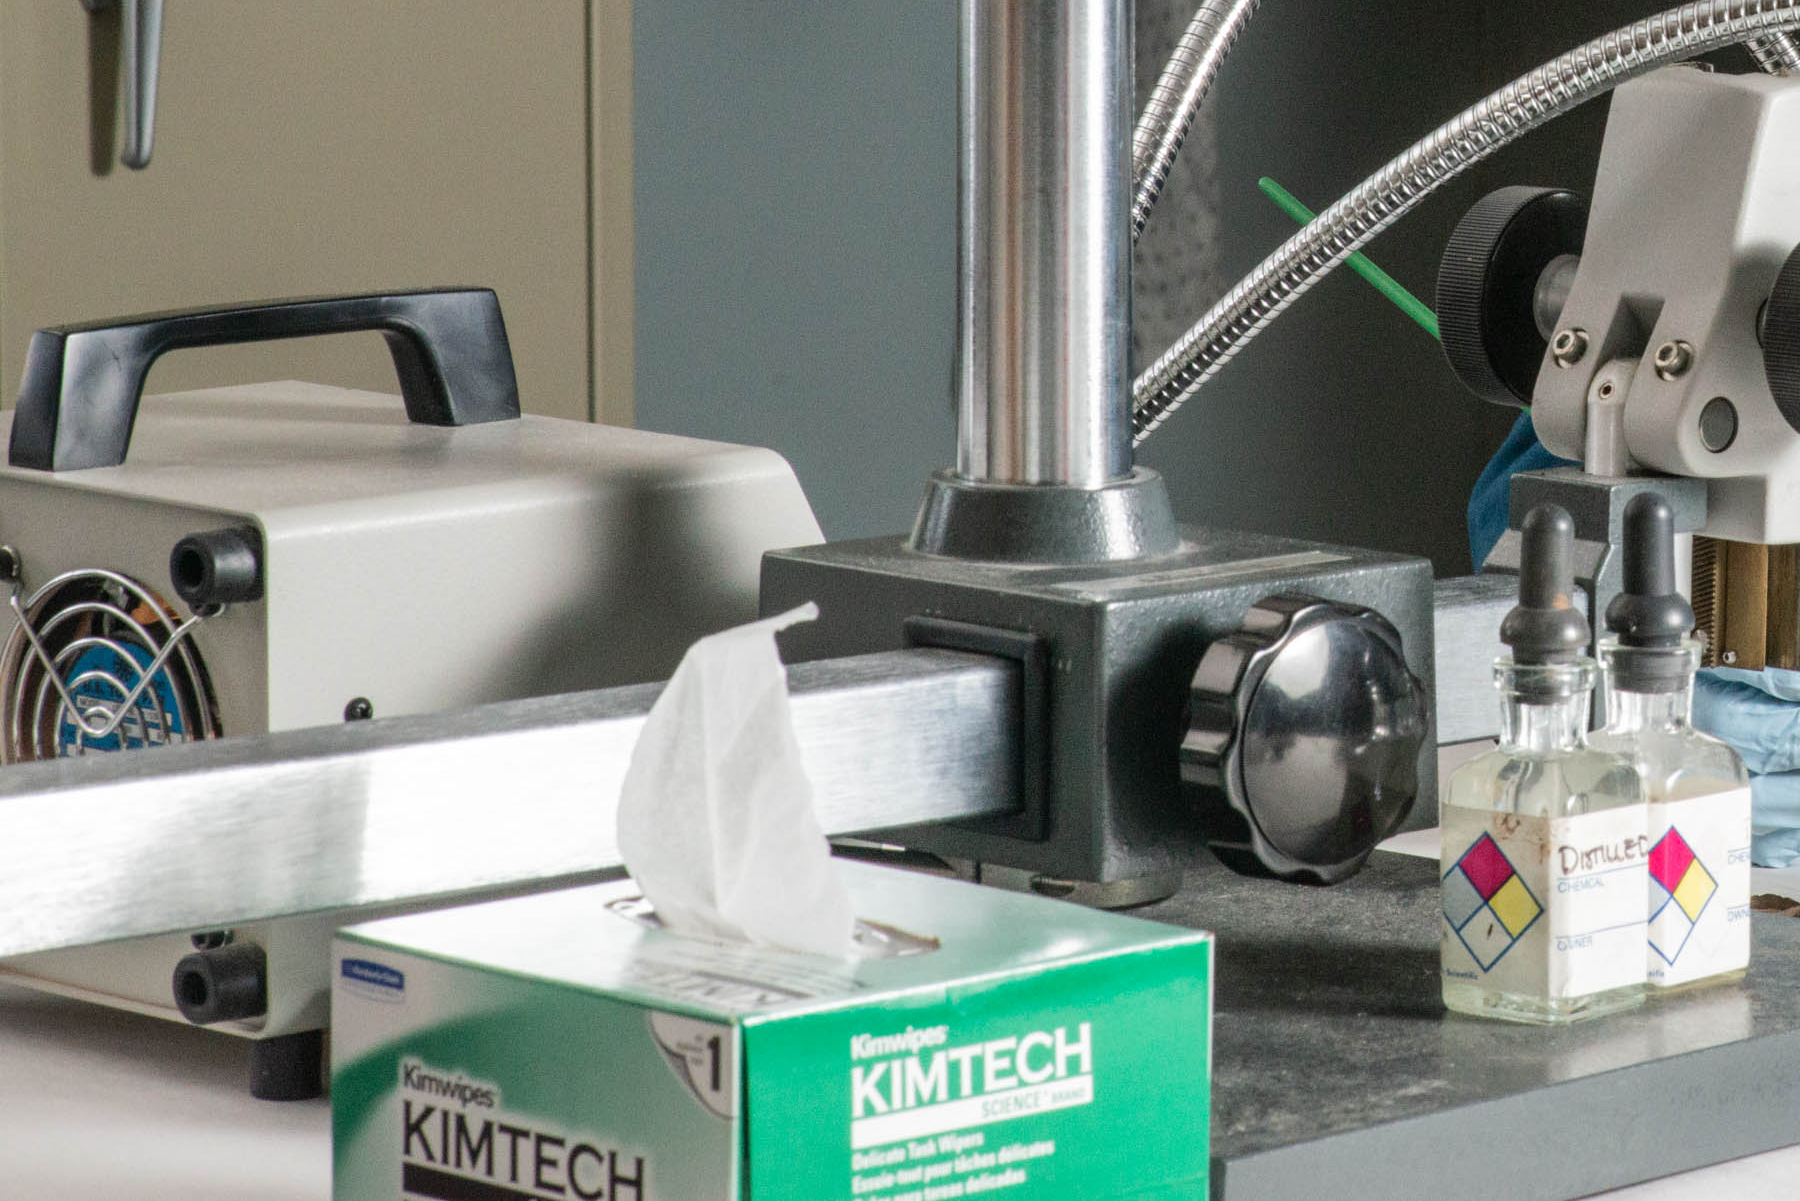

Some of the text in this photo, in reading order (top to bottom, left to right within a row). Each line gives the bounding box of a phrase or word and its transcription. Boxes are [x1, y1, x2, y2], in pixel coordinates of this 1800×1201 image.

[707, 1035, 720, 1091] 1
[851, 1025, 949, 1060] Kimwipes
[403, 1062, 495, 1109] Kimwipes
[851, 1021, 1093, 1118] KIMTECH
[981, 1090, 1041, 1119] SCIENCE
[402, 1099, 645, 1201] KIMTECH
